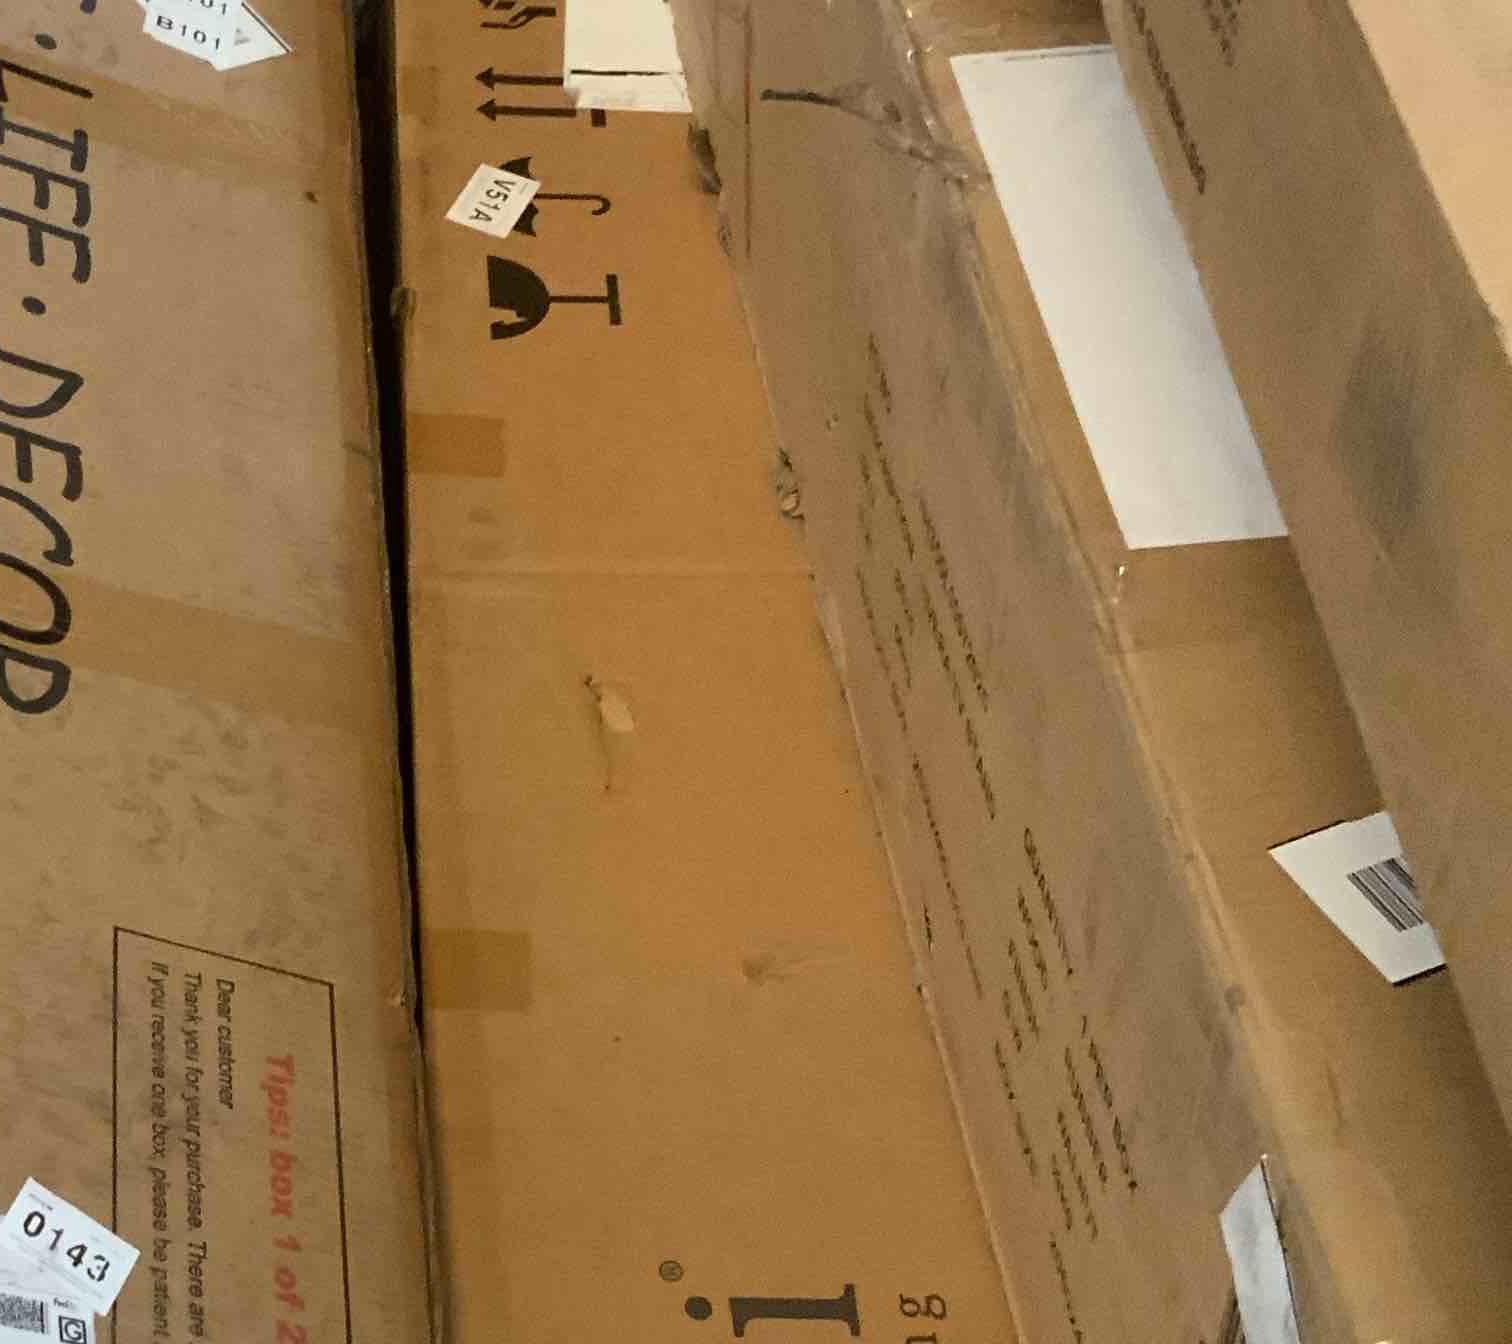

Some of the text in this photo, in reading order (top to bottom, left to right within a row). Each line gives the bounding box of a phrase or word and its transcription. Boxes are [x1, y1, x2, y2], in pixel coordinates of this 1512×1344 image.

[155, 14, 222, 52] B101
[467, 171, 516, 226] V51A
[151, 960, 169, 976] If
[147, 975, 165, 1009] you
[184, 971, 203, 1024] Thank
[151, 1013, 166, 1079] receive
[181, 1026, 199, 1062] you
[216, 977, 237, 1110] Dear customer
[184, 1065, 205, 1092] for
[151, 1083, 166, 1118] one
[181, 1093, 201, 1137] your
[149, 1165, 169, 1231] please
[178, 1137, 206, 1231] purchase.
[269, 1149, 298, 1217] box
[22, 1209, 111, 1283] 0143
[152, 1236, 171, 1264] be
[273, 1235, 302, 1252] 1
[187, 1240, 208, 1298] There
[274, 1267, 306, 1310] of
[149, 1265, 171, 1336] patient
[187, 1301, 205, 1337] are
[63, 1318, 83, 1342] G
